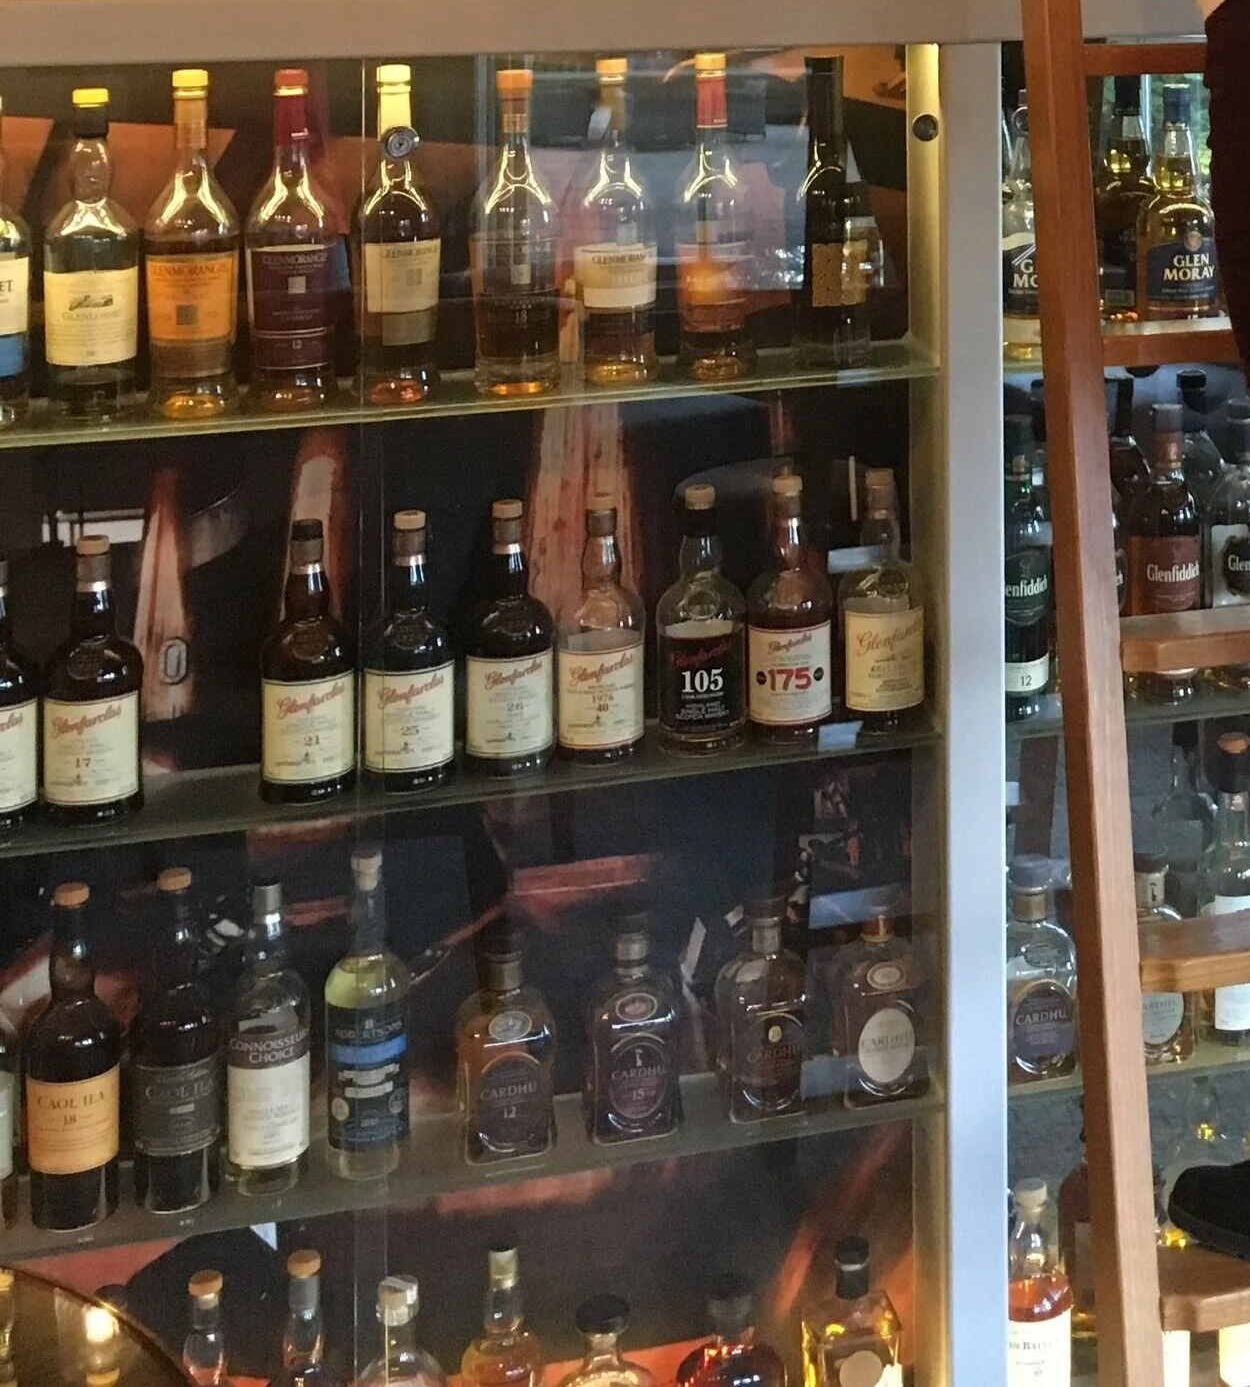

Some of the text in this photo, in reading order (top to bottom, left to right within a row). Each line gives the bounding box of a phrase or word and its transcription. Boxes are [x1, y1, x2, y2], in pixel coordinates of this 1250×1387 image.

[1172, 253, 1210, 269] GLEN
[1162, 265, 1216, 282] MORAY
[1146, 560, 1200, 583] Glenfiddich
[567, 652, 635, 687] Glenfarclas
[681, 667, 725, 694] 105
[767, 666, 813, 692] 175
[1020, 674, 1033, 687] 12
[376, 672, 445, 710] Glenfarclas
[276, 681, 345, 720] Glenfarclas
[50, 703, 122, 738] Glenfarclas
[303, 734, 321, 747] 21
[74, 757, 92, 768] 17
[1015, 1007, 1069, 1026] CARDHU
[248, 1047, 296, 1065] CHOICE
[611, 1064, 668, 1081] CARDHU
[479, 1080, 537, 1100] CARDHU
[36, 1094, 76, 1112] CAOL
[502, 1106, 517, 1119] 12
